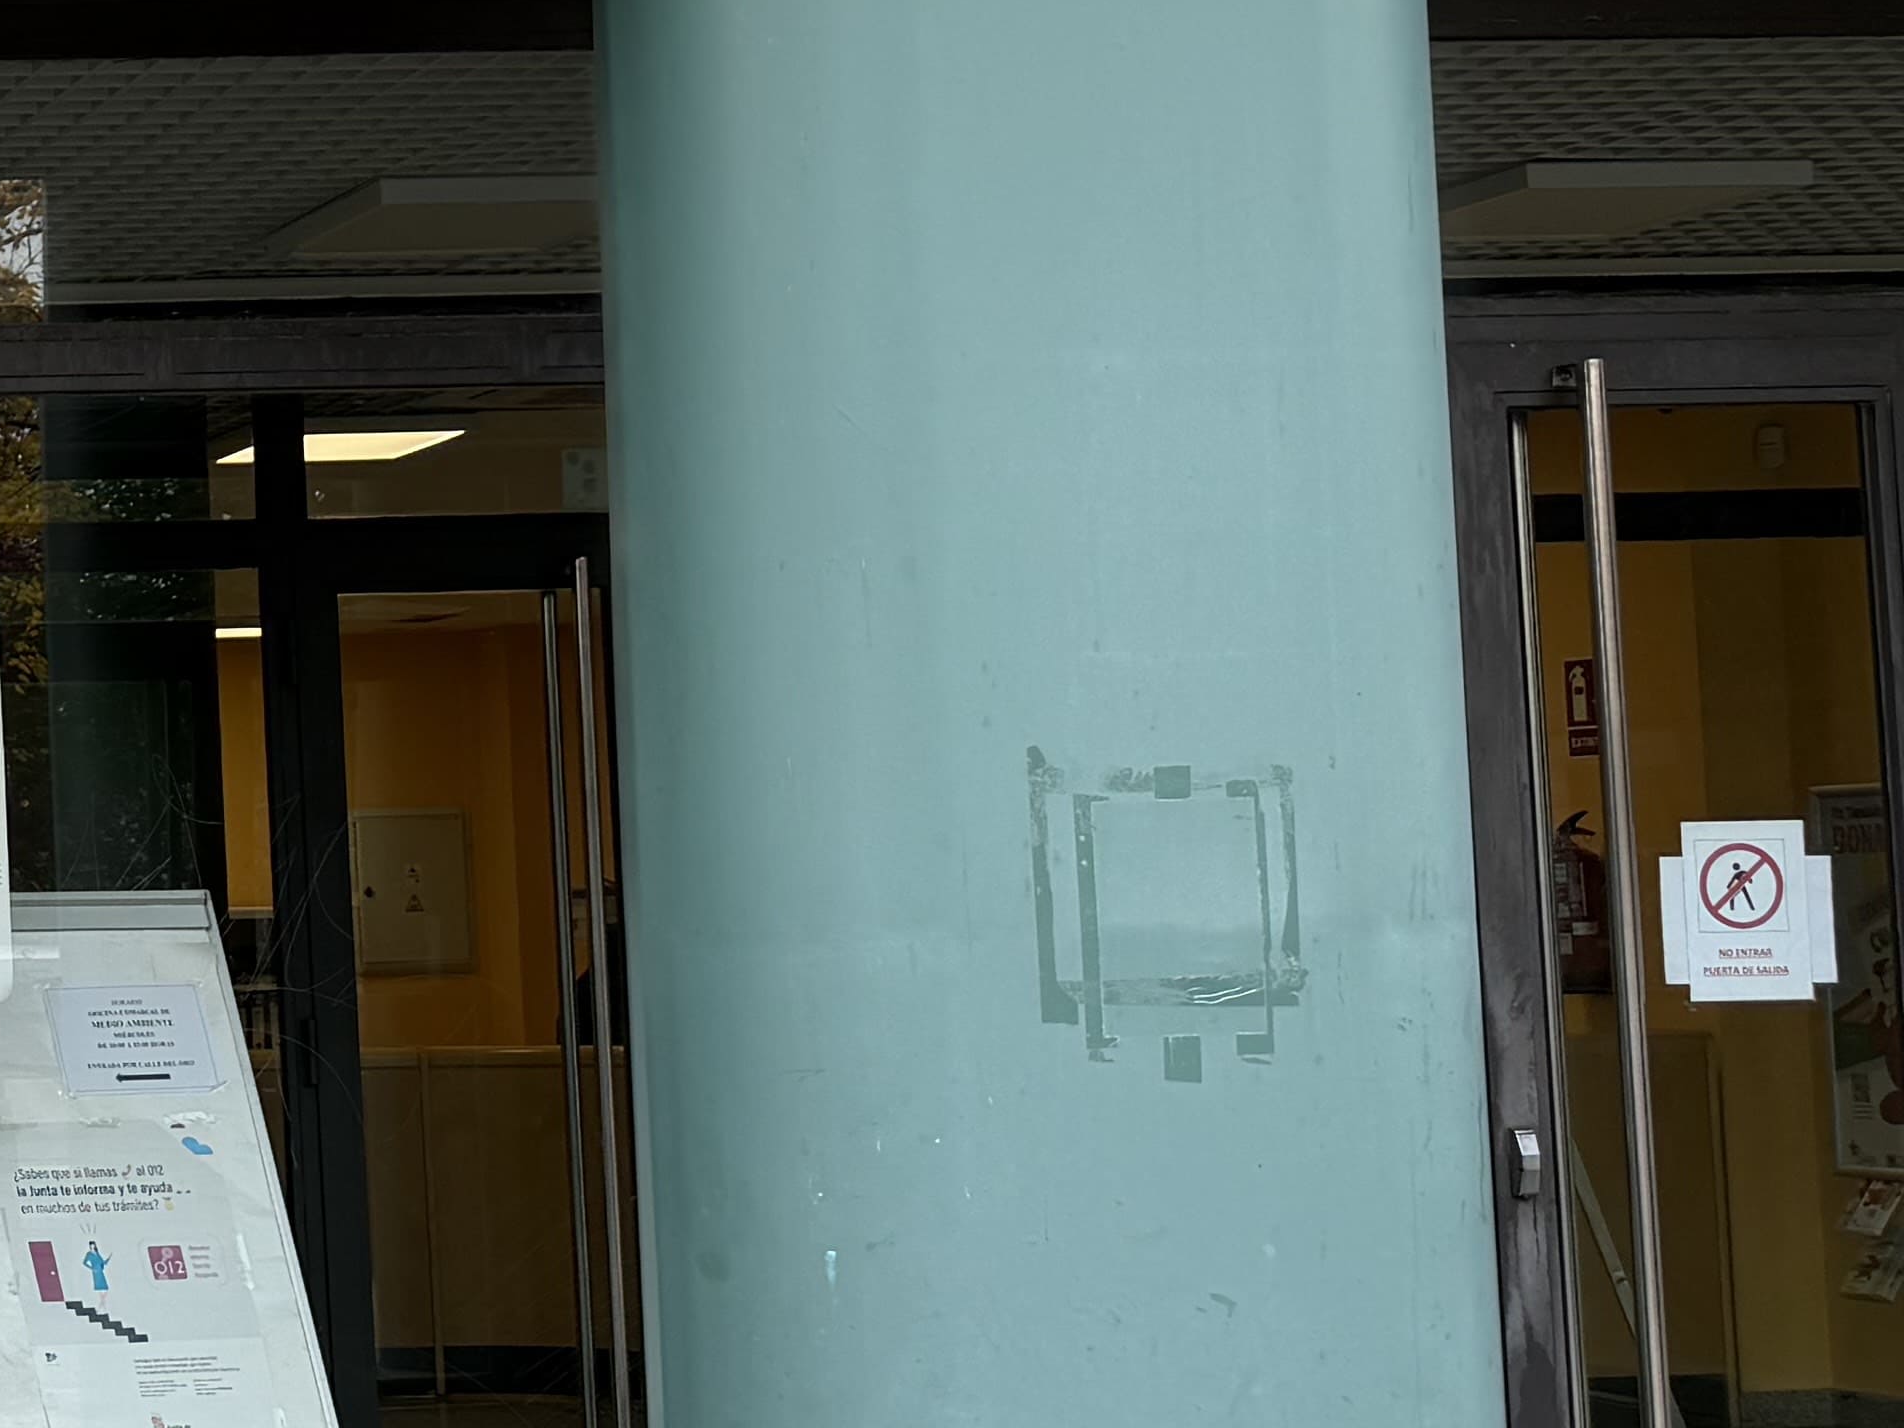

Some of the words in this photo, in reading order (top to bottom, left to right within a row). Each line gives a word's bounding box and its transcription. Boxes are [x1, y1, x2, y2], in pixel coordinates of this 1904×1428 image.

[1719, 948, 1734, 957] NO
[1736, 948, 1773, 957] ENTRAR
[1704, 966, 1740, 975] PUERTA
[1756, 965, 1789, 974] SALIDA
[51, 1169, 71, 1181] que
[16, 1186, 27, 1197] la
[29, 1186, 59, 1197] Junta
[140, 1181, 173, 1196] ayuda
[21, 1205, 34, 1215] en
[78, 1201, 91, 1212] de
[94, 1202, 111, 1212] tus
